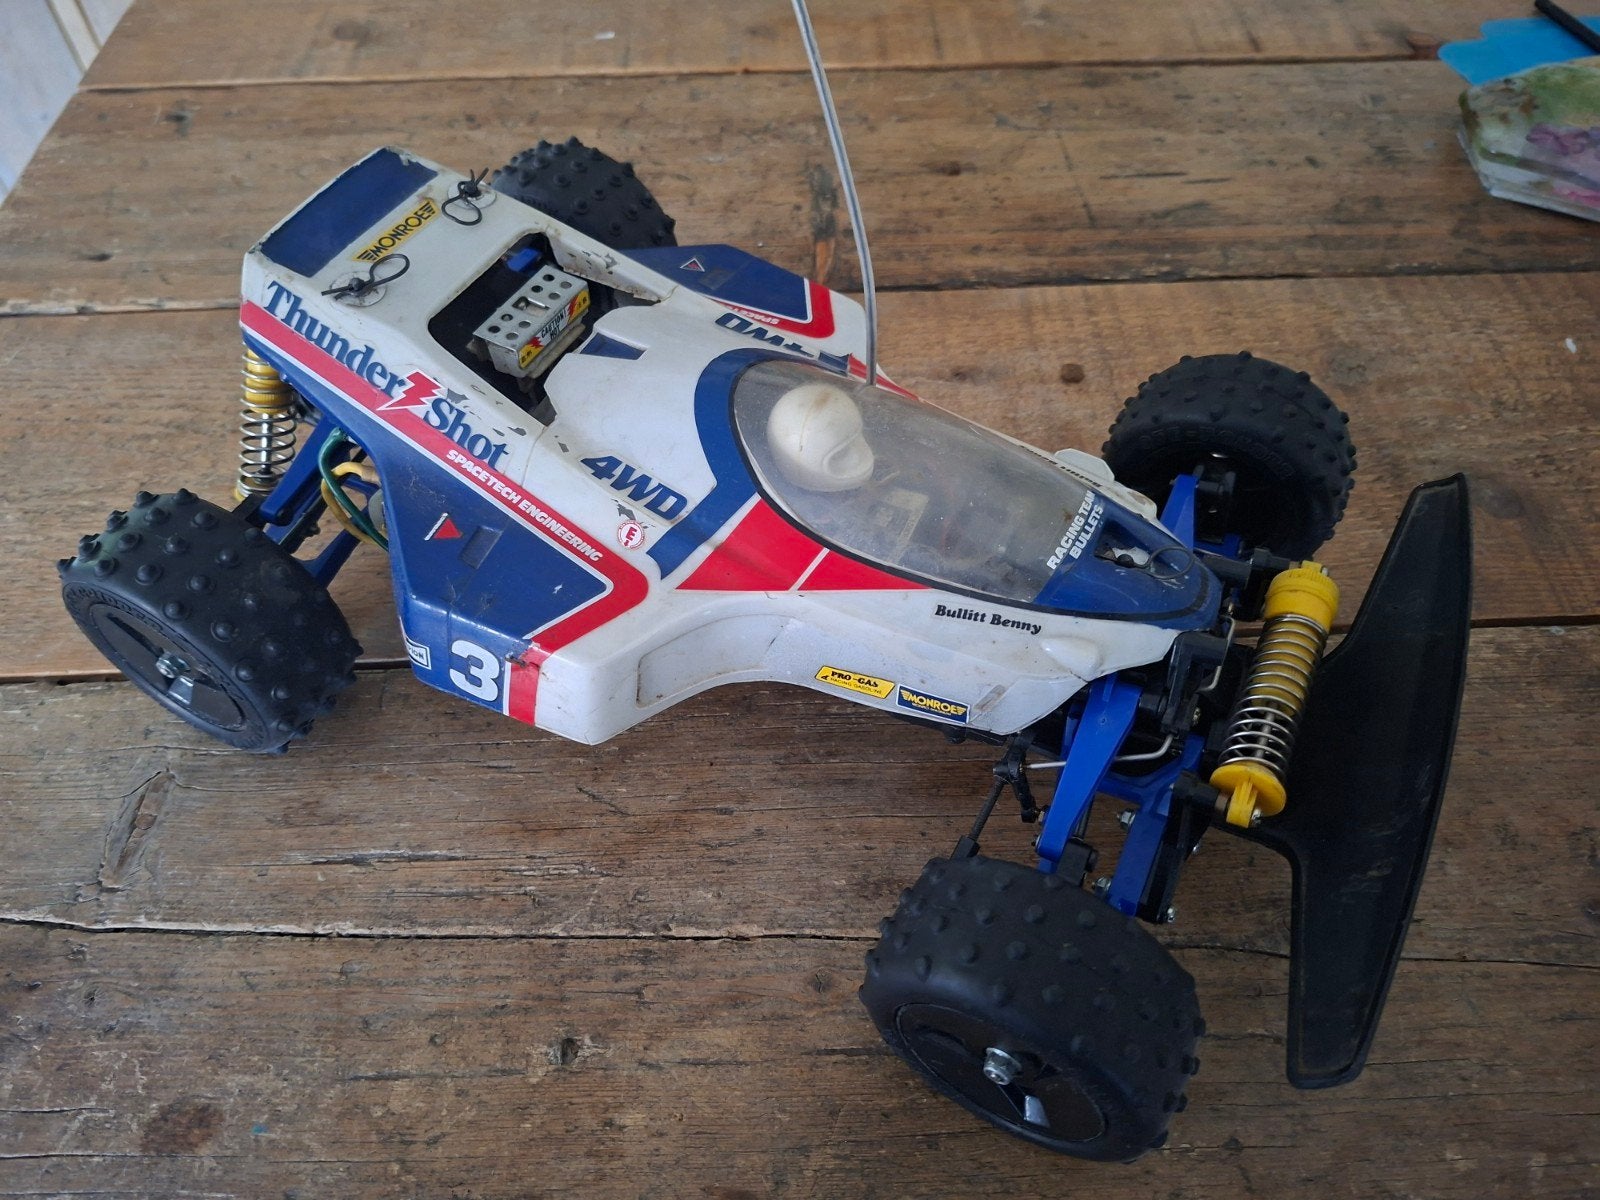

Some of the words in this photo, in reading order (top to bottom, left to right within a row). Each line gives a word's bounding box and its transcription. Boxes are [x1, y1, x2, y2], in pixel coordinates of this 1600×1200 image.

[372, 205, 431, 258] MONROE
[264, 280, 406, 399] Thunder
[423, 398, 509, 470] Shot
[446, 449, 522, 504] SPACETECH
[518, 499, 604, 562] ENGINEERING
[580, 455, 689, 522] 4WD
[1047, 510, 1087, 570] RACING
[1080, 490, 1096, 519] TEAM
[1069, 503, 1104, 559] BULLETS
[935, 605, 986, 623] Bullitt
[989, 613, 1042, 635] Benny
[449, 639, 500, 702] 3
[908, 693, 958, 715] MONROE
